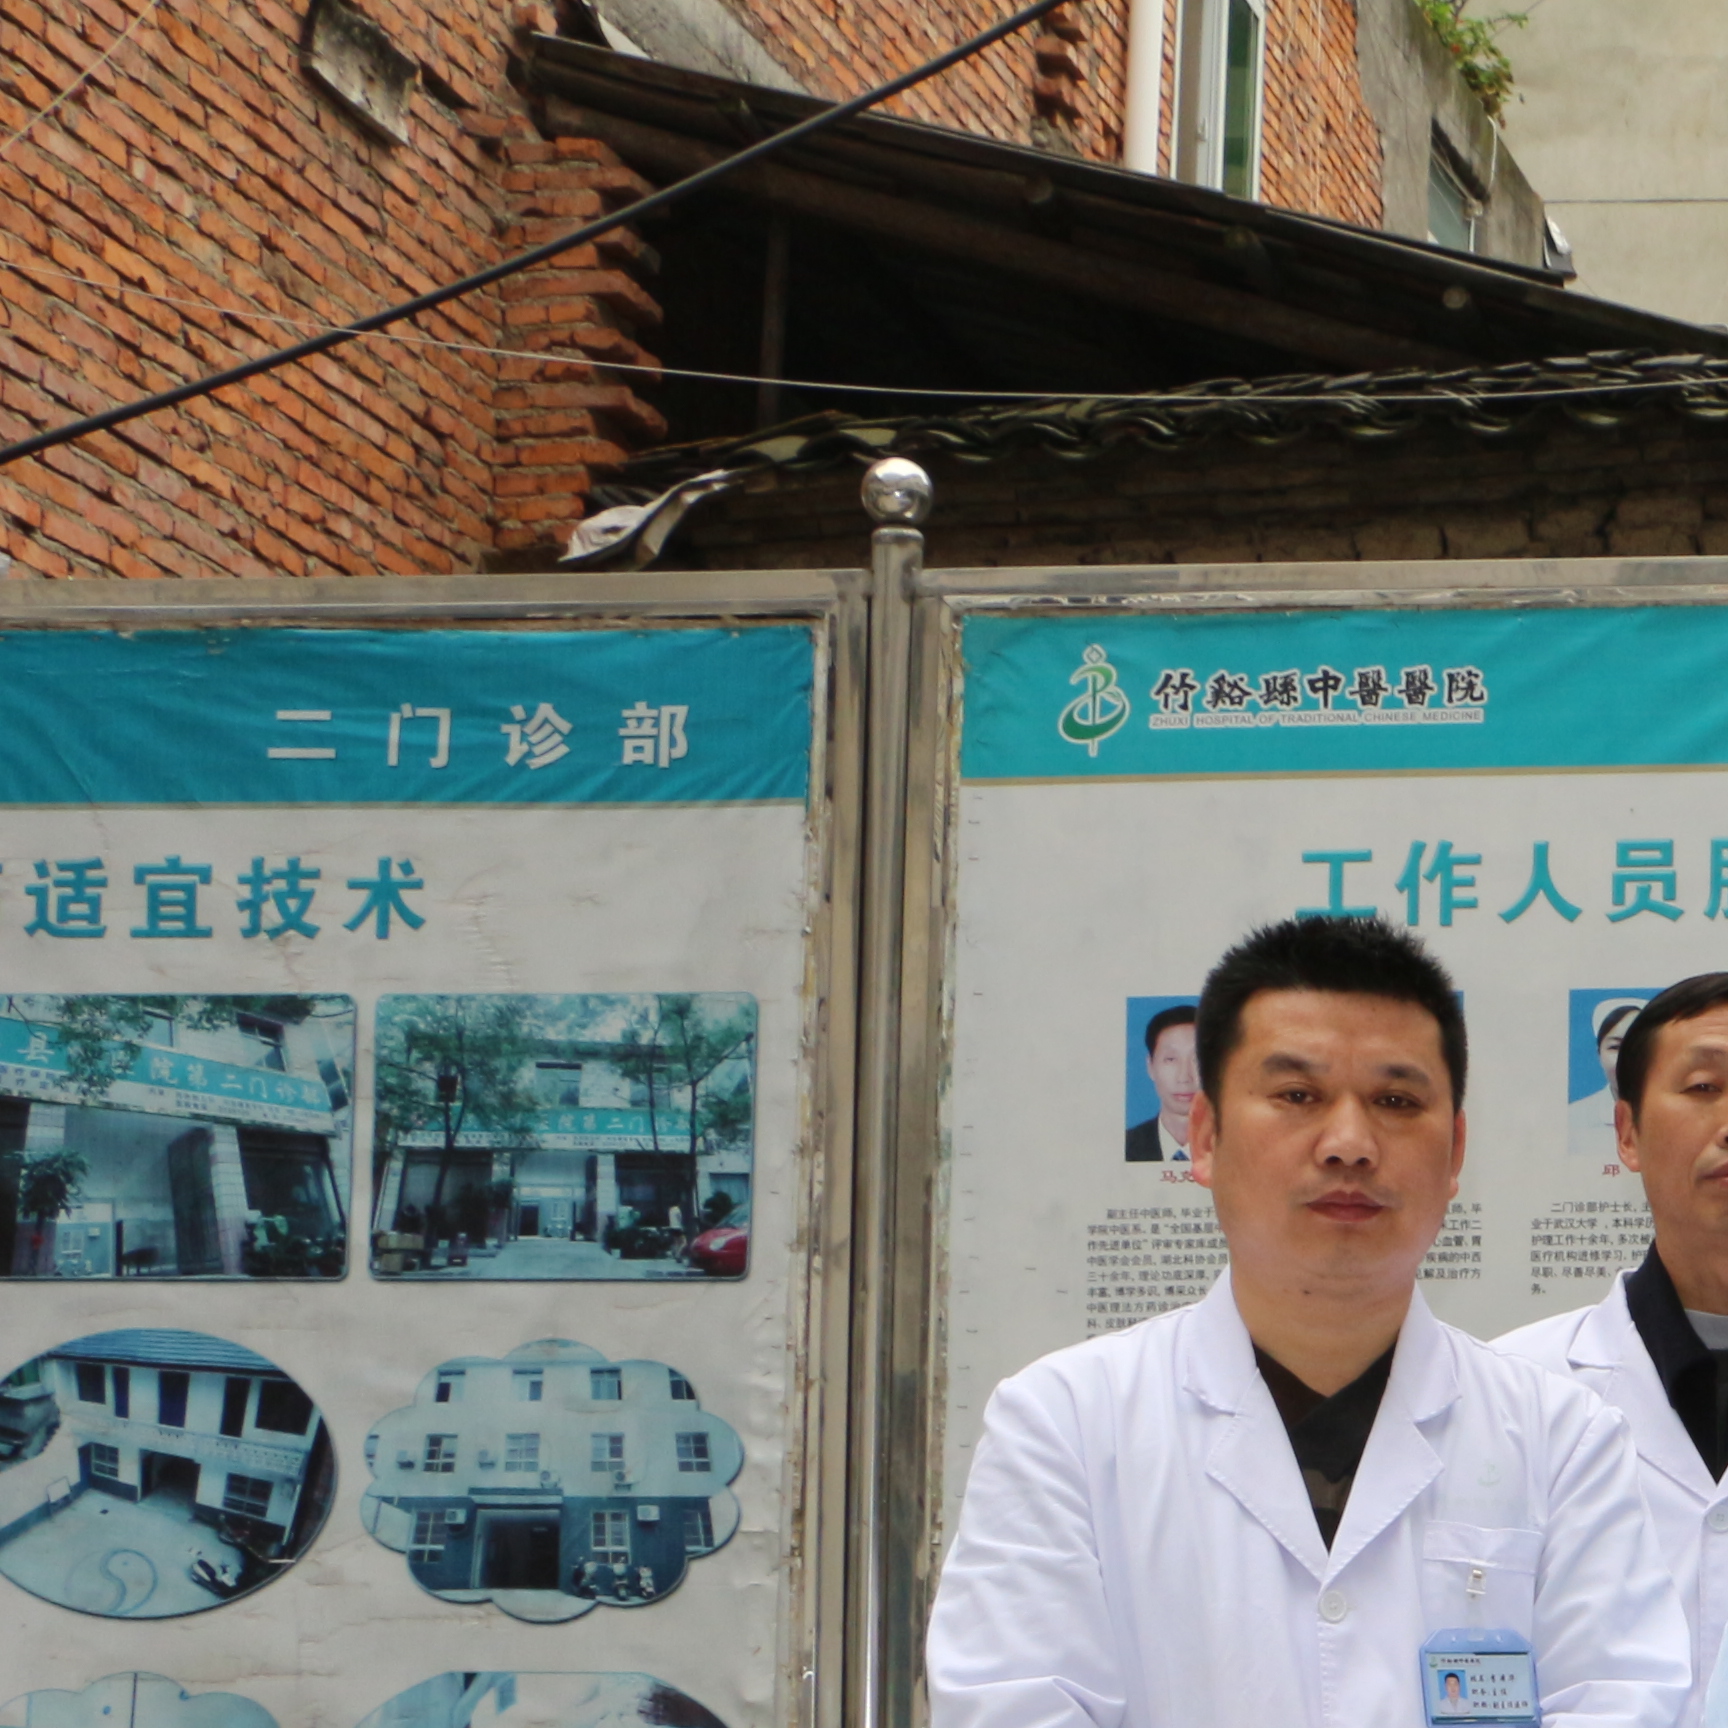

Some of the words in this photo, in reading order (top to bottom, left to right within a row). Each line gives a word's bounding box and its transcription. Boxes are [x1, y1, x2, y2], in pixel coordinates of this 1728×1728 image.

[267, 702, 690, 769] 二门诊部
[1151, 716, 1189, 727] ZHUXI
[1196, 714, 1256, 726] HOSPITAL
[1259, 714, 1276, 724] OF
[1280, 711, 1359, 724] TRADITIONAL
[1363, 711, 1418, 722] CHINESE
[1422, 709, 1483, 721] MEDICINE
[0, 855, 427, 940] 适宜技术
